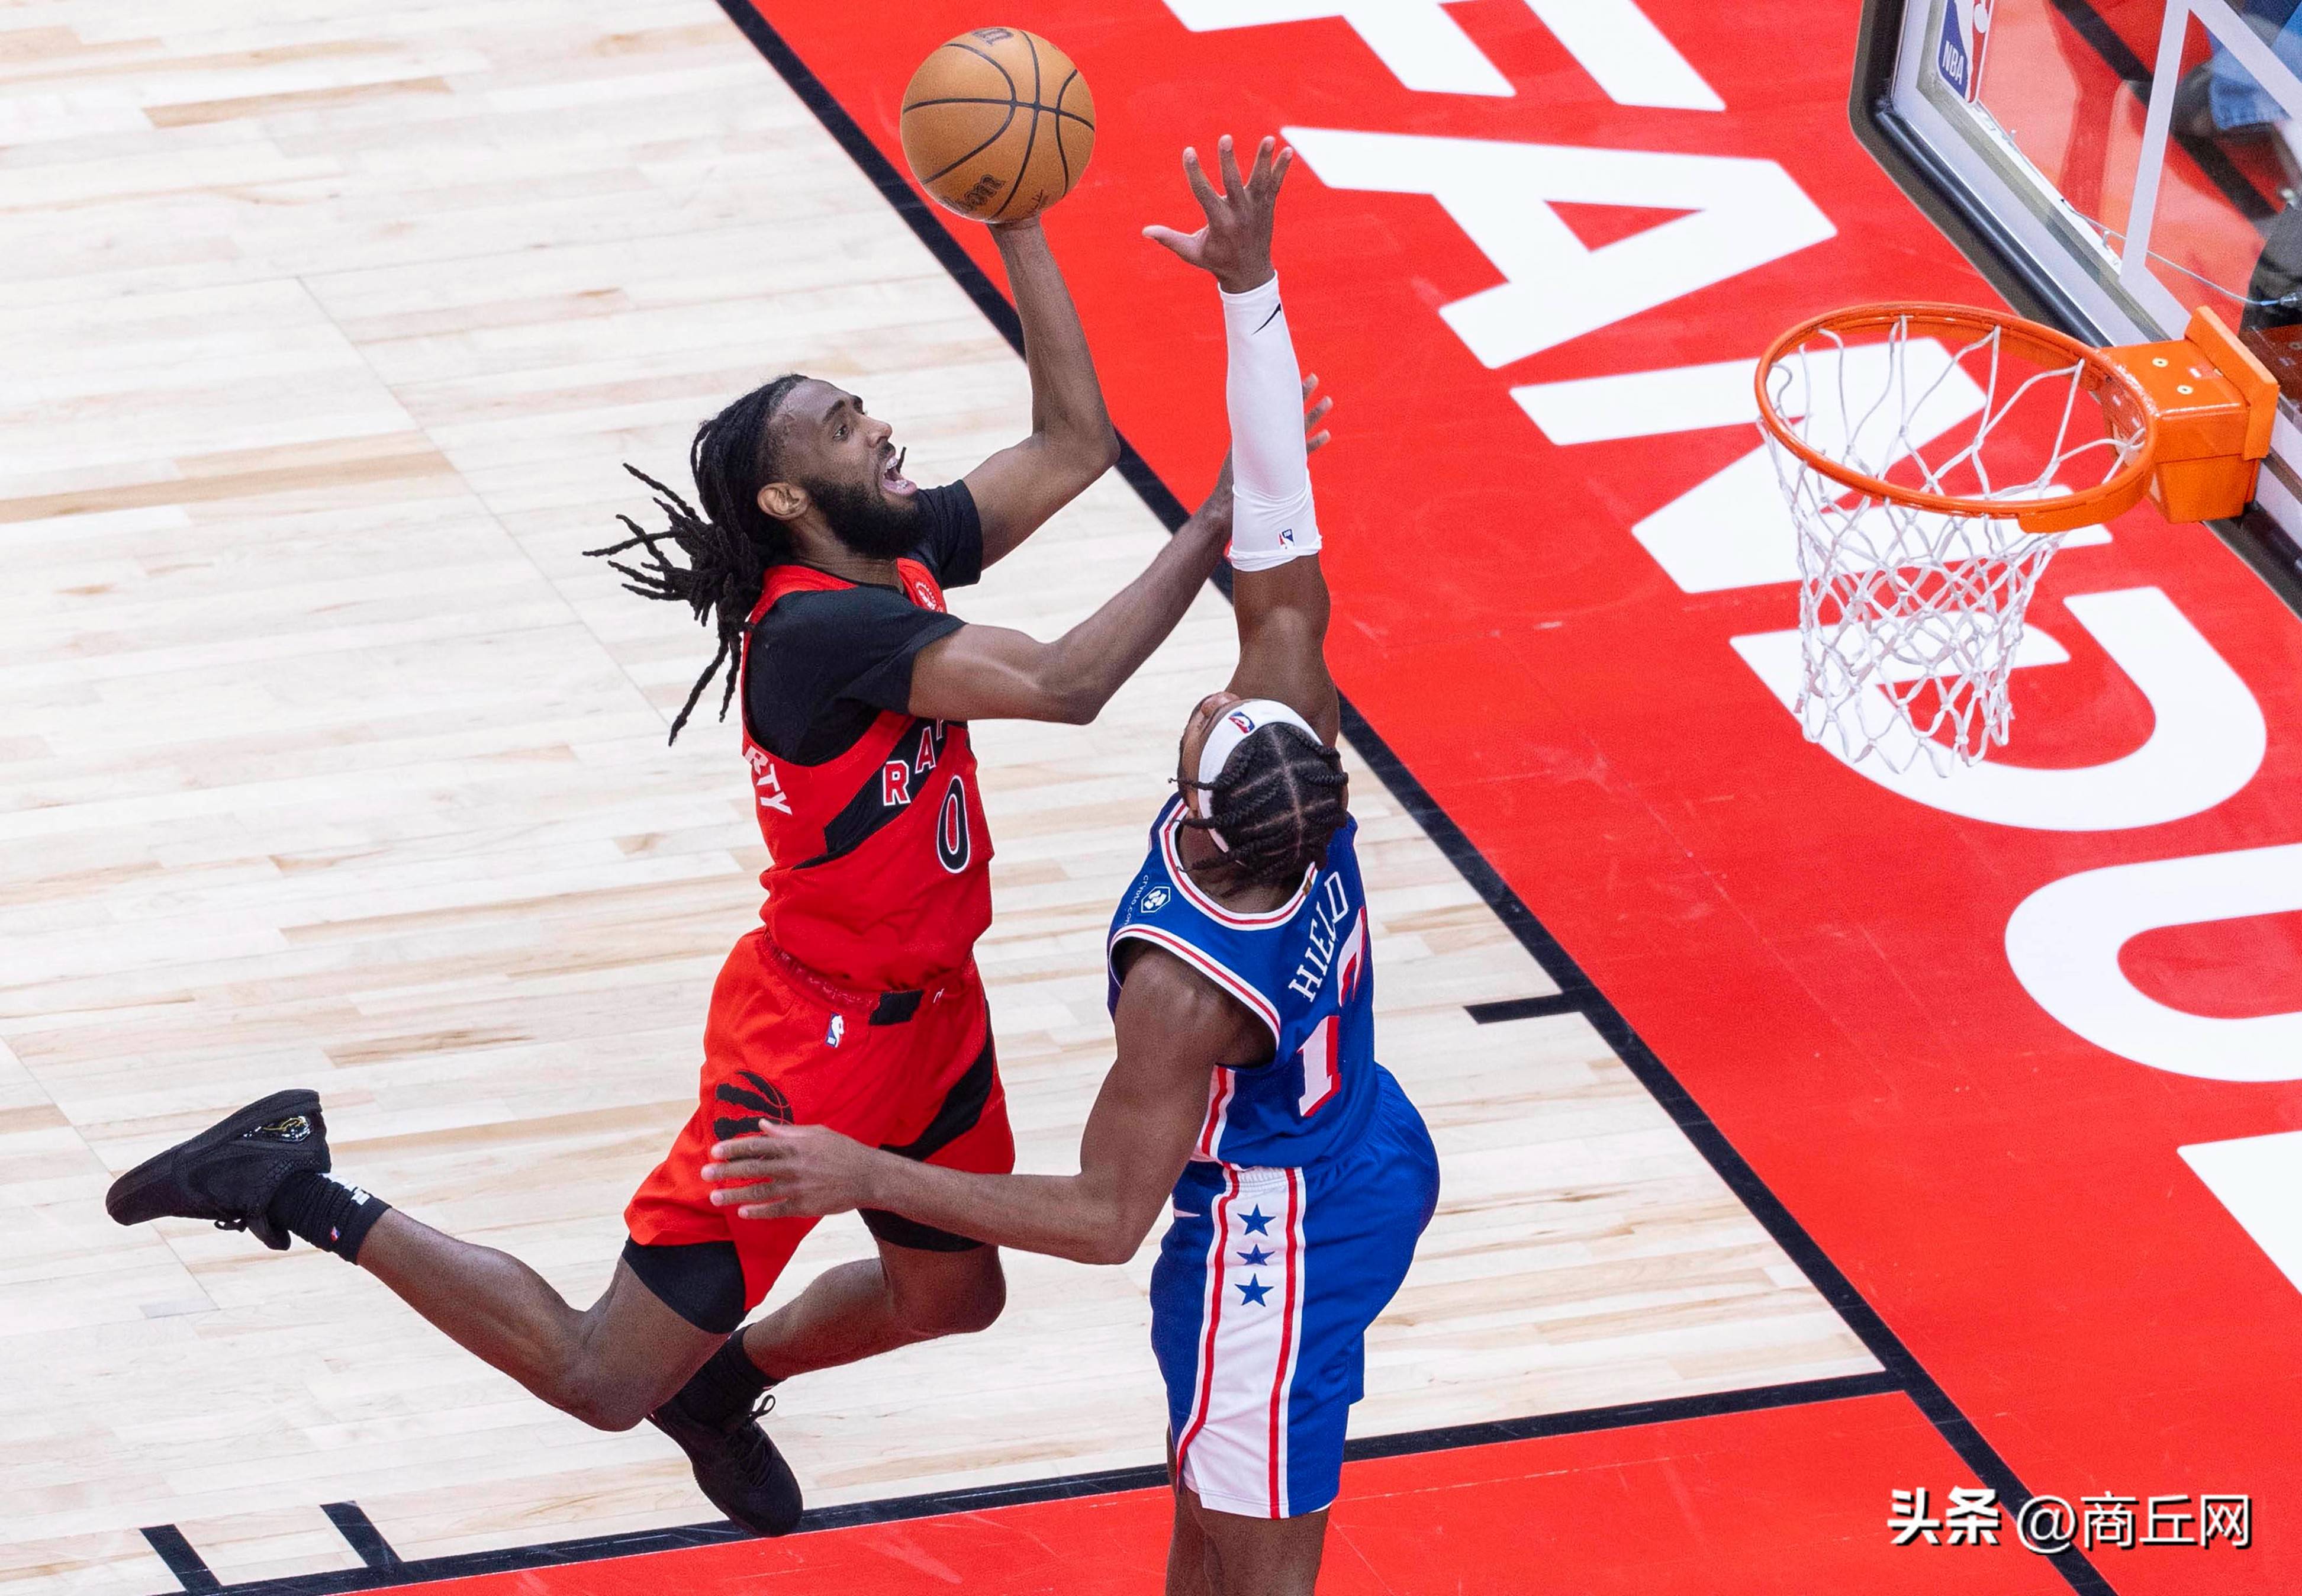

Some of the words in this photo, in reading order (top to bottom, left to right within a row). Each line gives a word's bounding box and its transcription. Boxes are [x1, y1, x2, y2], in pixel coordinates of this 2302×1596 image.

[1942, 40, 1964, 85] NBA
[936, 774, 971, 874] 0
[1288, 871, 1349, 1003] HIELD
